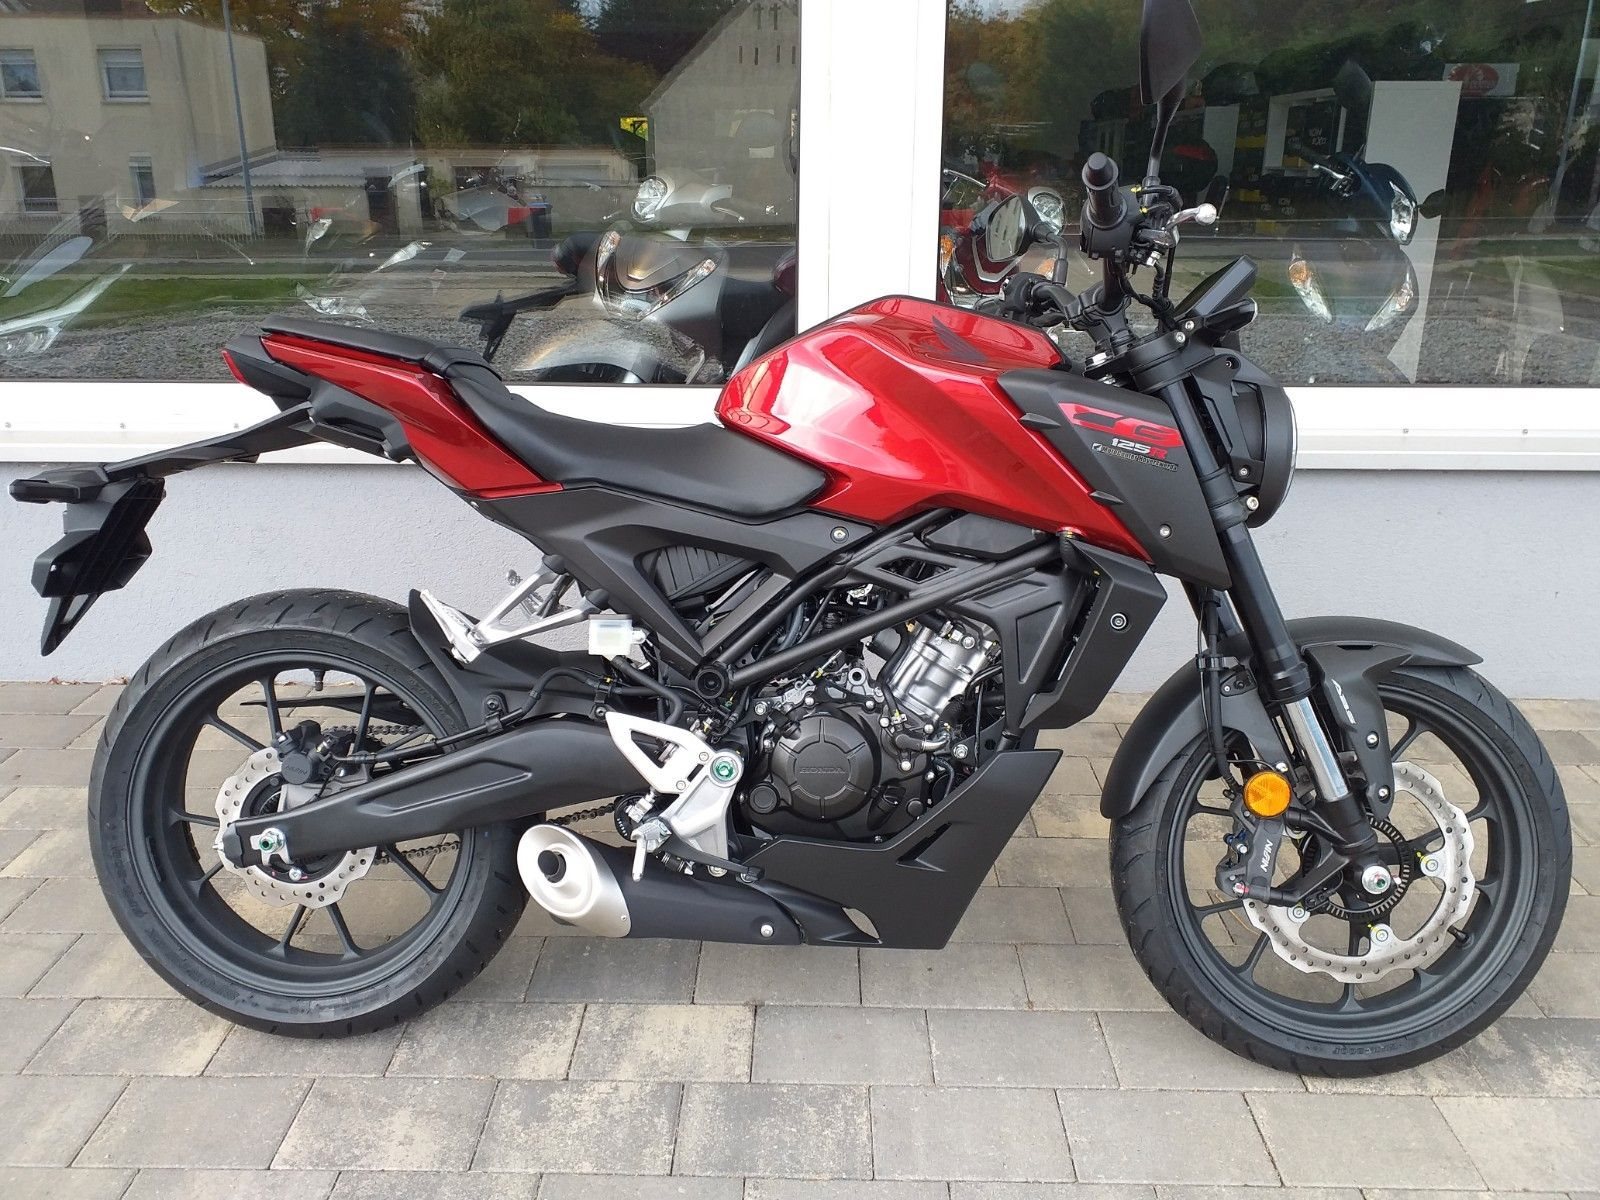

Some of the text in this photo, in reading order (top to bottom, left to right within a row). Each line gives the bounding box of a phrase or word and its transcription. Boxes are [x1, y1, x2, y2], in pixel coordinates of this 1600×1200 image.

[1111, 437, 1168, 460] 125R
[1331, 679, 1357, 725] ABS
[799, 766, 846, 774] HONDA
